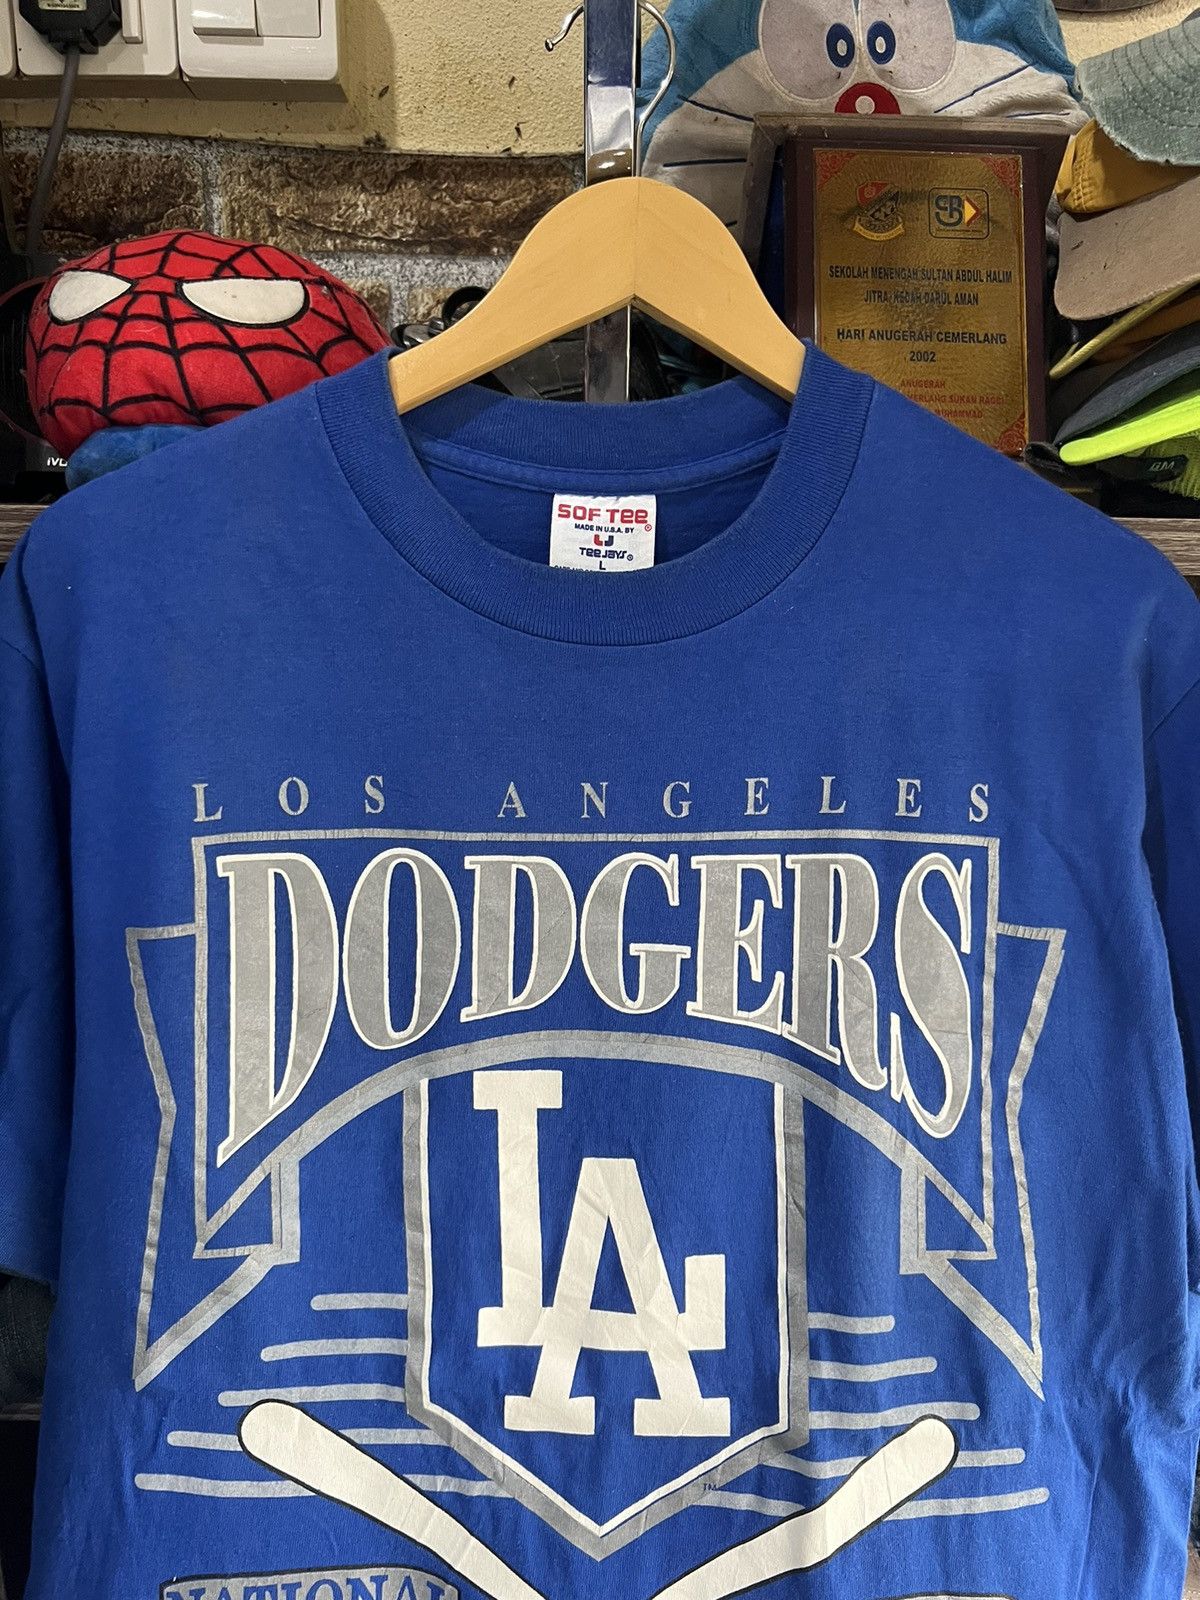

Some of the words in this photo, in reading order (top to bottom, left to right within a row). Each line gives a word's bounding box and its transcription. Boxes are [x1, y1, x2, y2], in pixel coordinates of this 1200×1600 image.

[829, 265, 868, 279] SEKOLAH
[871, 267, 918, 281] MENENGAH
[921, 268, 953, 282] SULTAN
[956, 269, 984, 283] ABDUL
[986, 270, 1012, 284] HALIM
[954, 293, 979, 305] AMAN
[837, 328, 864, 341] HARI
[868, 330, 933, 342] ANUGERAH
[936, 332, 1008, 345] CEMERLANG
[909, 351, 937, 363] 2002
[900, 379, 946, 389] ANUGERAH
[558, 504, 601, 521] SOF
[575, 523, 594, 532] MADE
[599, 561, 606, 570] L
[192, 775, 386, 822] LOS
[497, 776, 990, 822] ANGELES
[216, 848, 974, 1166] DODGERS
[473, 1069, 731, 1436] LA
